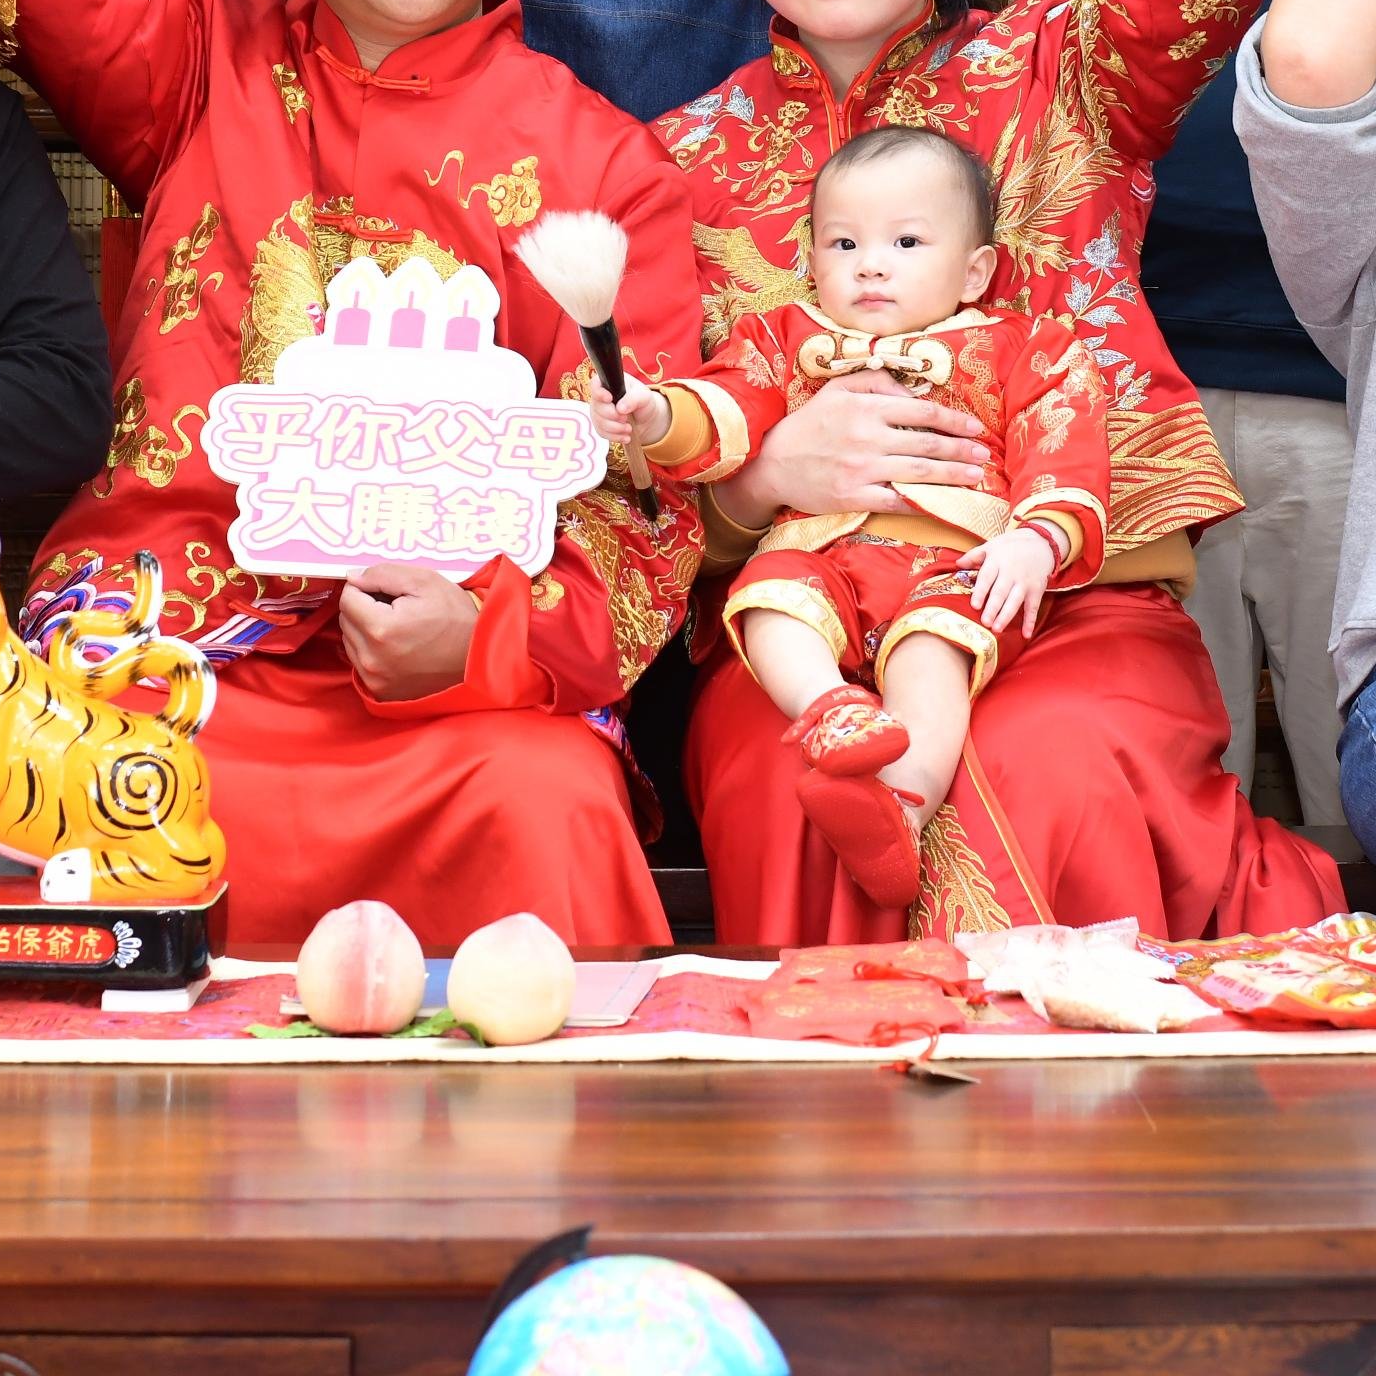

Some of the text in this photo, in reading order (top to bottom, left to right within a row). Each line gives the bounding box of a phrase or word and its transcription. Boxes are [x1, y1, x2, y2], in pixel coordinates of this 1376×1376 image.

[223, 400, 585, 481] 乎你父母
[249, 477, 533, 556] 大賺錢
